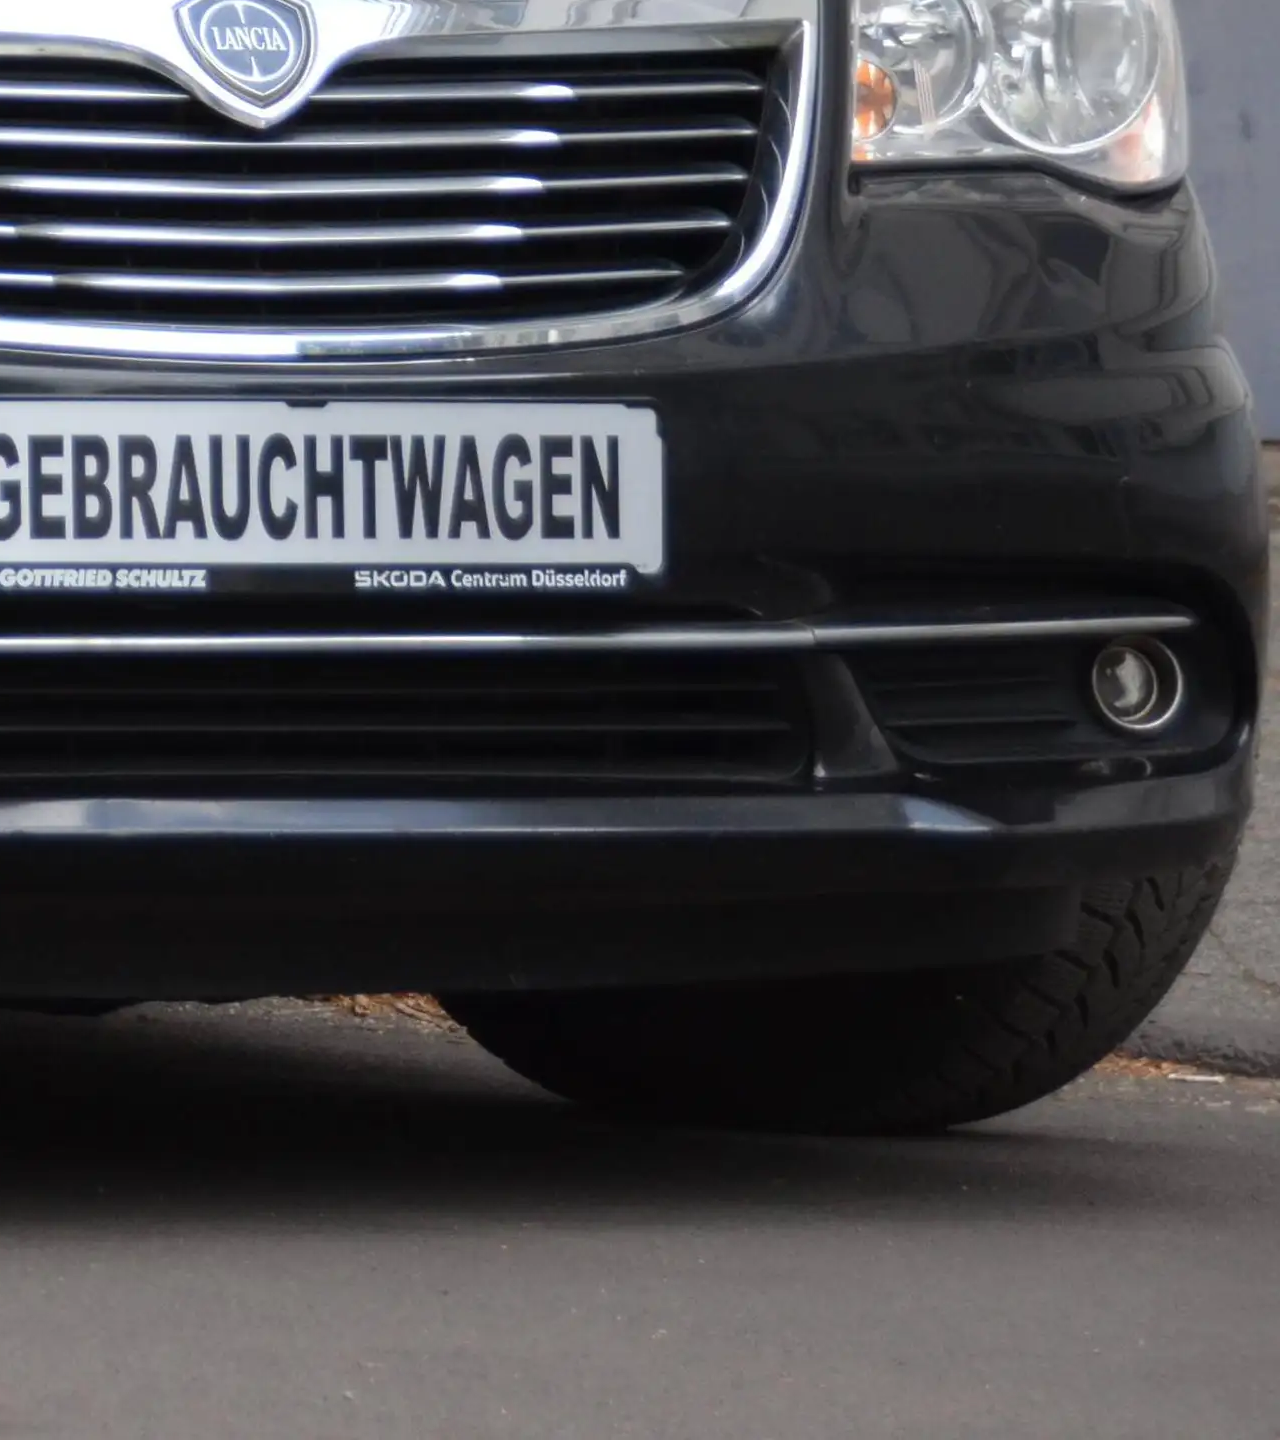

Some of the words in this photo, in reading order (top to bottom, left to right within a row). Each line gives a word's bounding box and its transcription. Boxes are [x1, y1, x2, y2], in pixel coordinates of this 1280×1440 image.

[210, 25, 287, 51] LANCIA
[115, 569, 207, 588] SCHULTZ
[450, 569, 527, 588] Centrum
[531, 569, 628, 588] Düsseldorf
